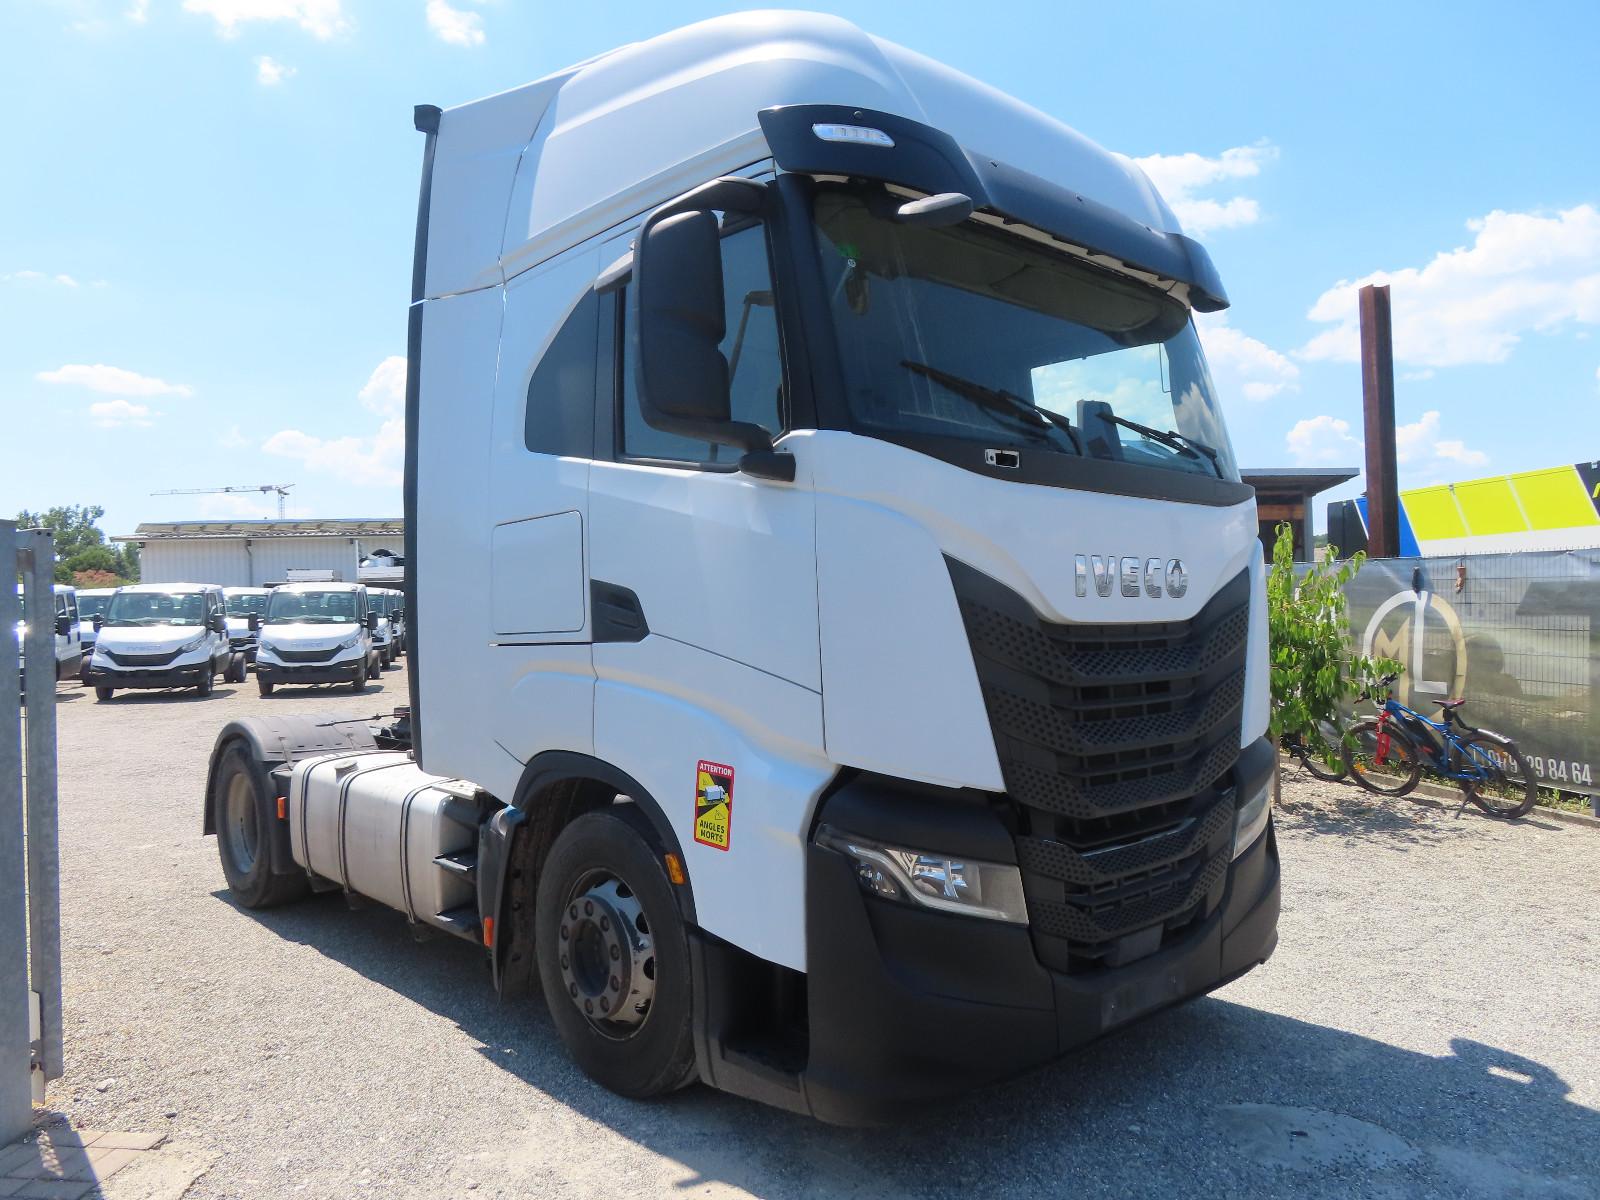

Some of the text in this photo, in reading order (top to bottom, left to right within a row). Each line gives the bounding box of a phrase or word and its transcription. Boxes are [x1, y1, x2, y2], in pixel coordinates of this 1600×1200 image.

[1074, 553, 1189, 599] IVECO
[699, 762, 732, 776] ATTENTION
[1547, 758, 1569, 782] 84
[1571, 761, 1593, 786] 64
[699, 820, 725, 833] ANGLES
[700, 829, 724, 843] MORTS
